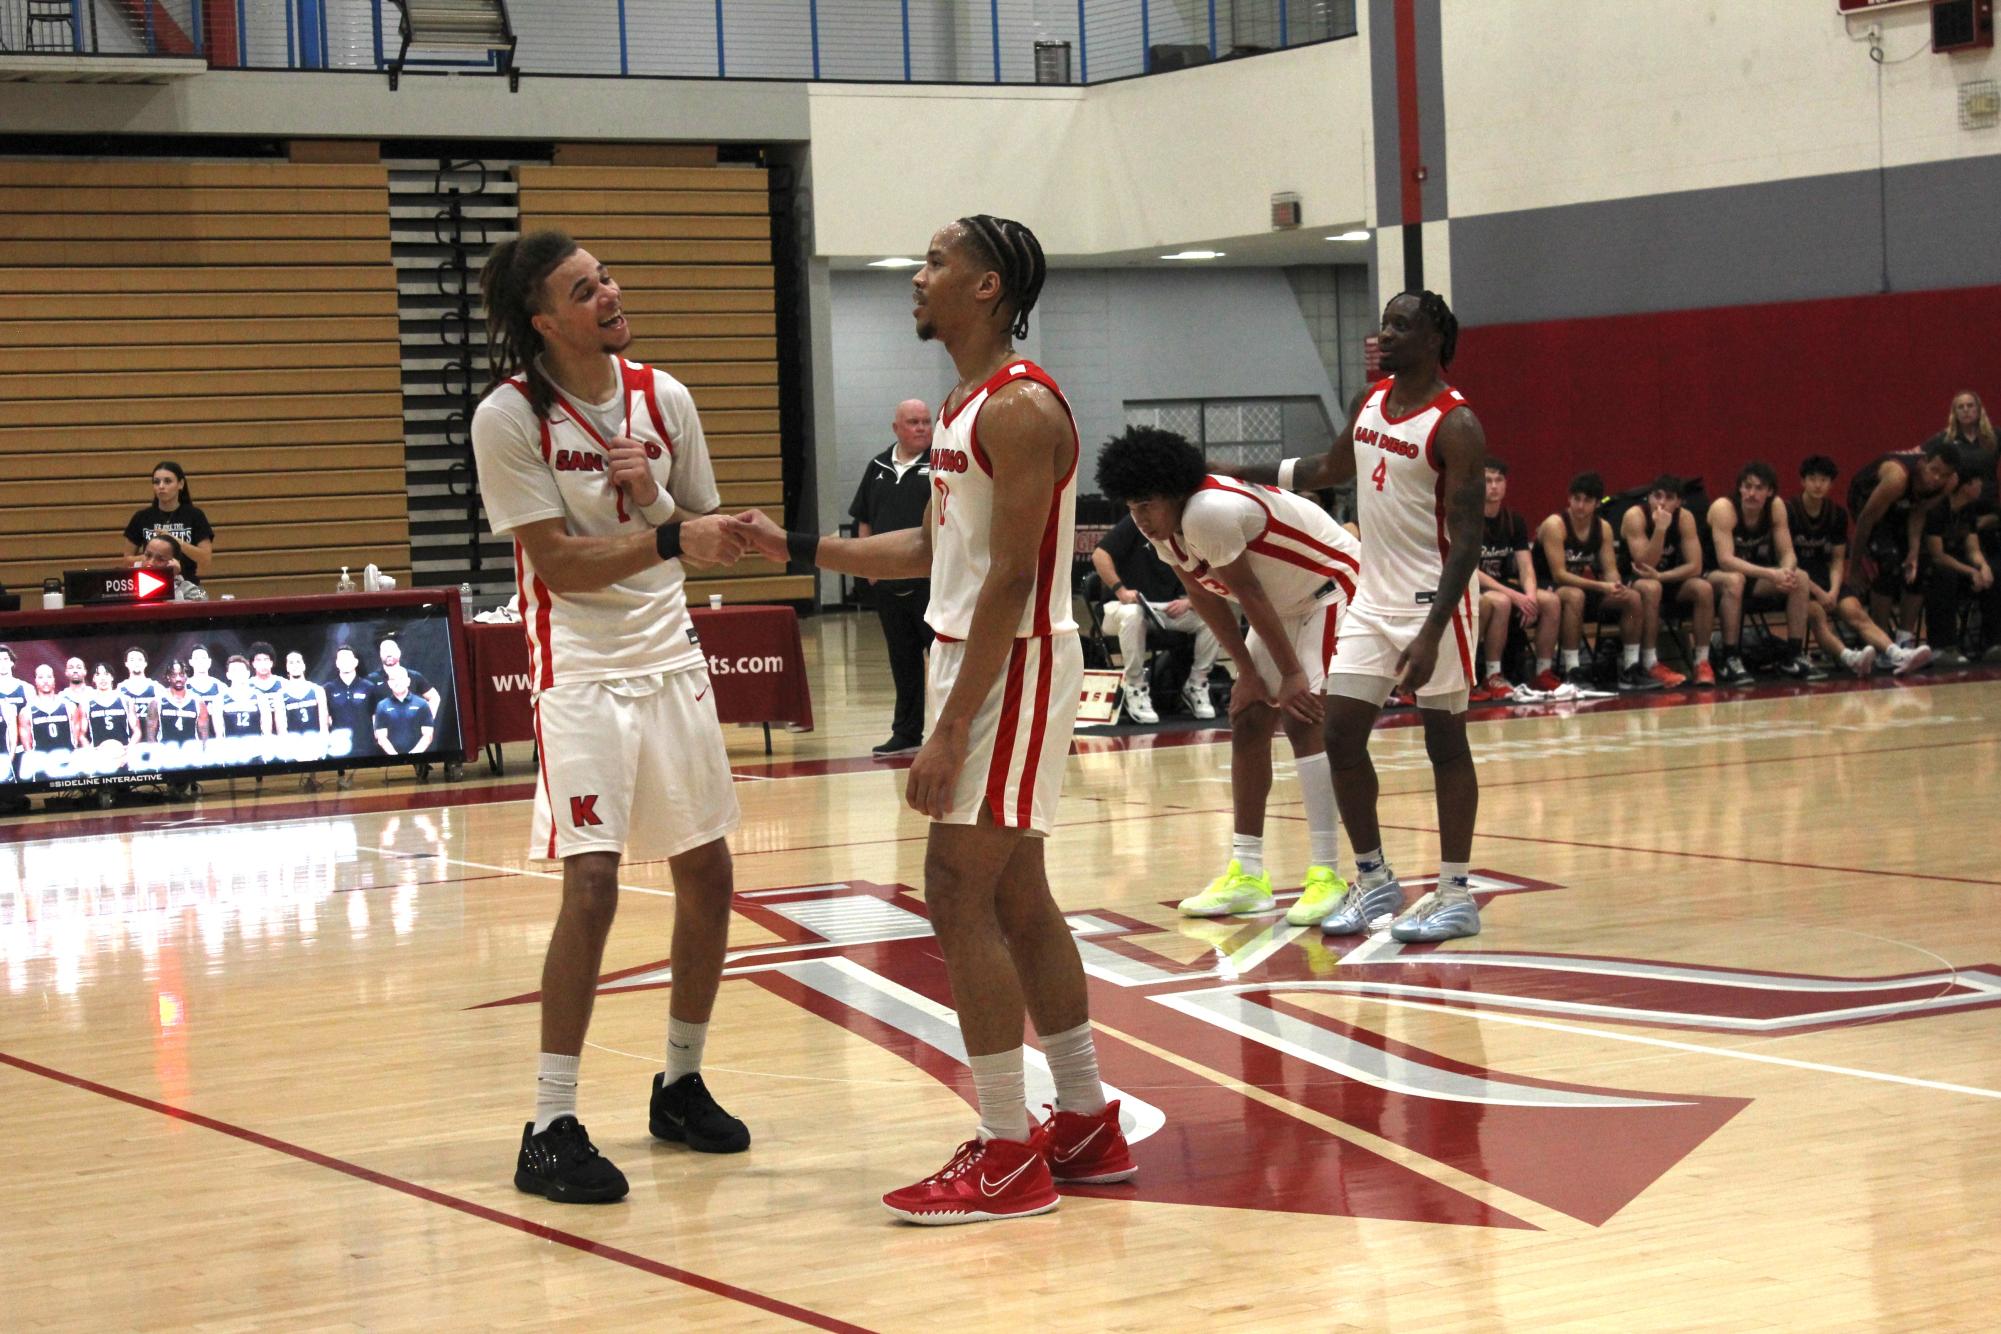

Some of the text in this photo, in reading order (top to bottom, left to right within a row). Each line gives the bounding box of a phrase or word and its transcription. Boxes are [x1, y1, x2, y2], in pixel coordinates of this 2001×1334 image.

[1378, 434, 1419, 459] DIEGO
[555, 450, 604, 471] SAN
[1372, 457, 1386, 491] 4
[709, 655, 783, 676] ts.com
[104, 715, 114, 730] 5
[174, 718, 184, 731] 4
[236, 712, 250, 726] 12
[48, 722, 58, 738] 0
[102, 773, 163, 785] INTERACTIVE
[569, 795, 604, 828] K
